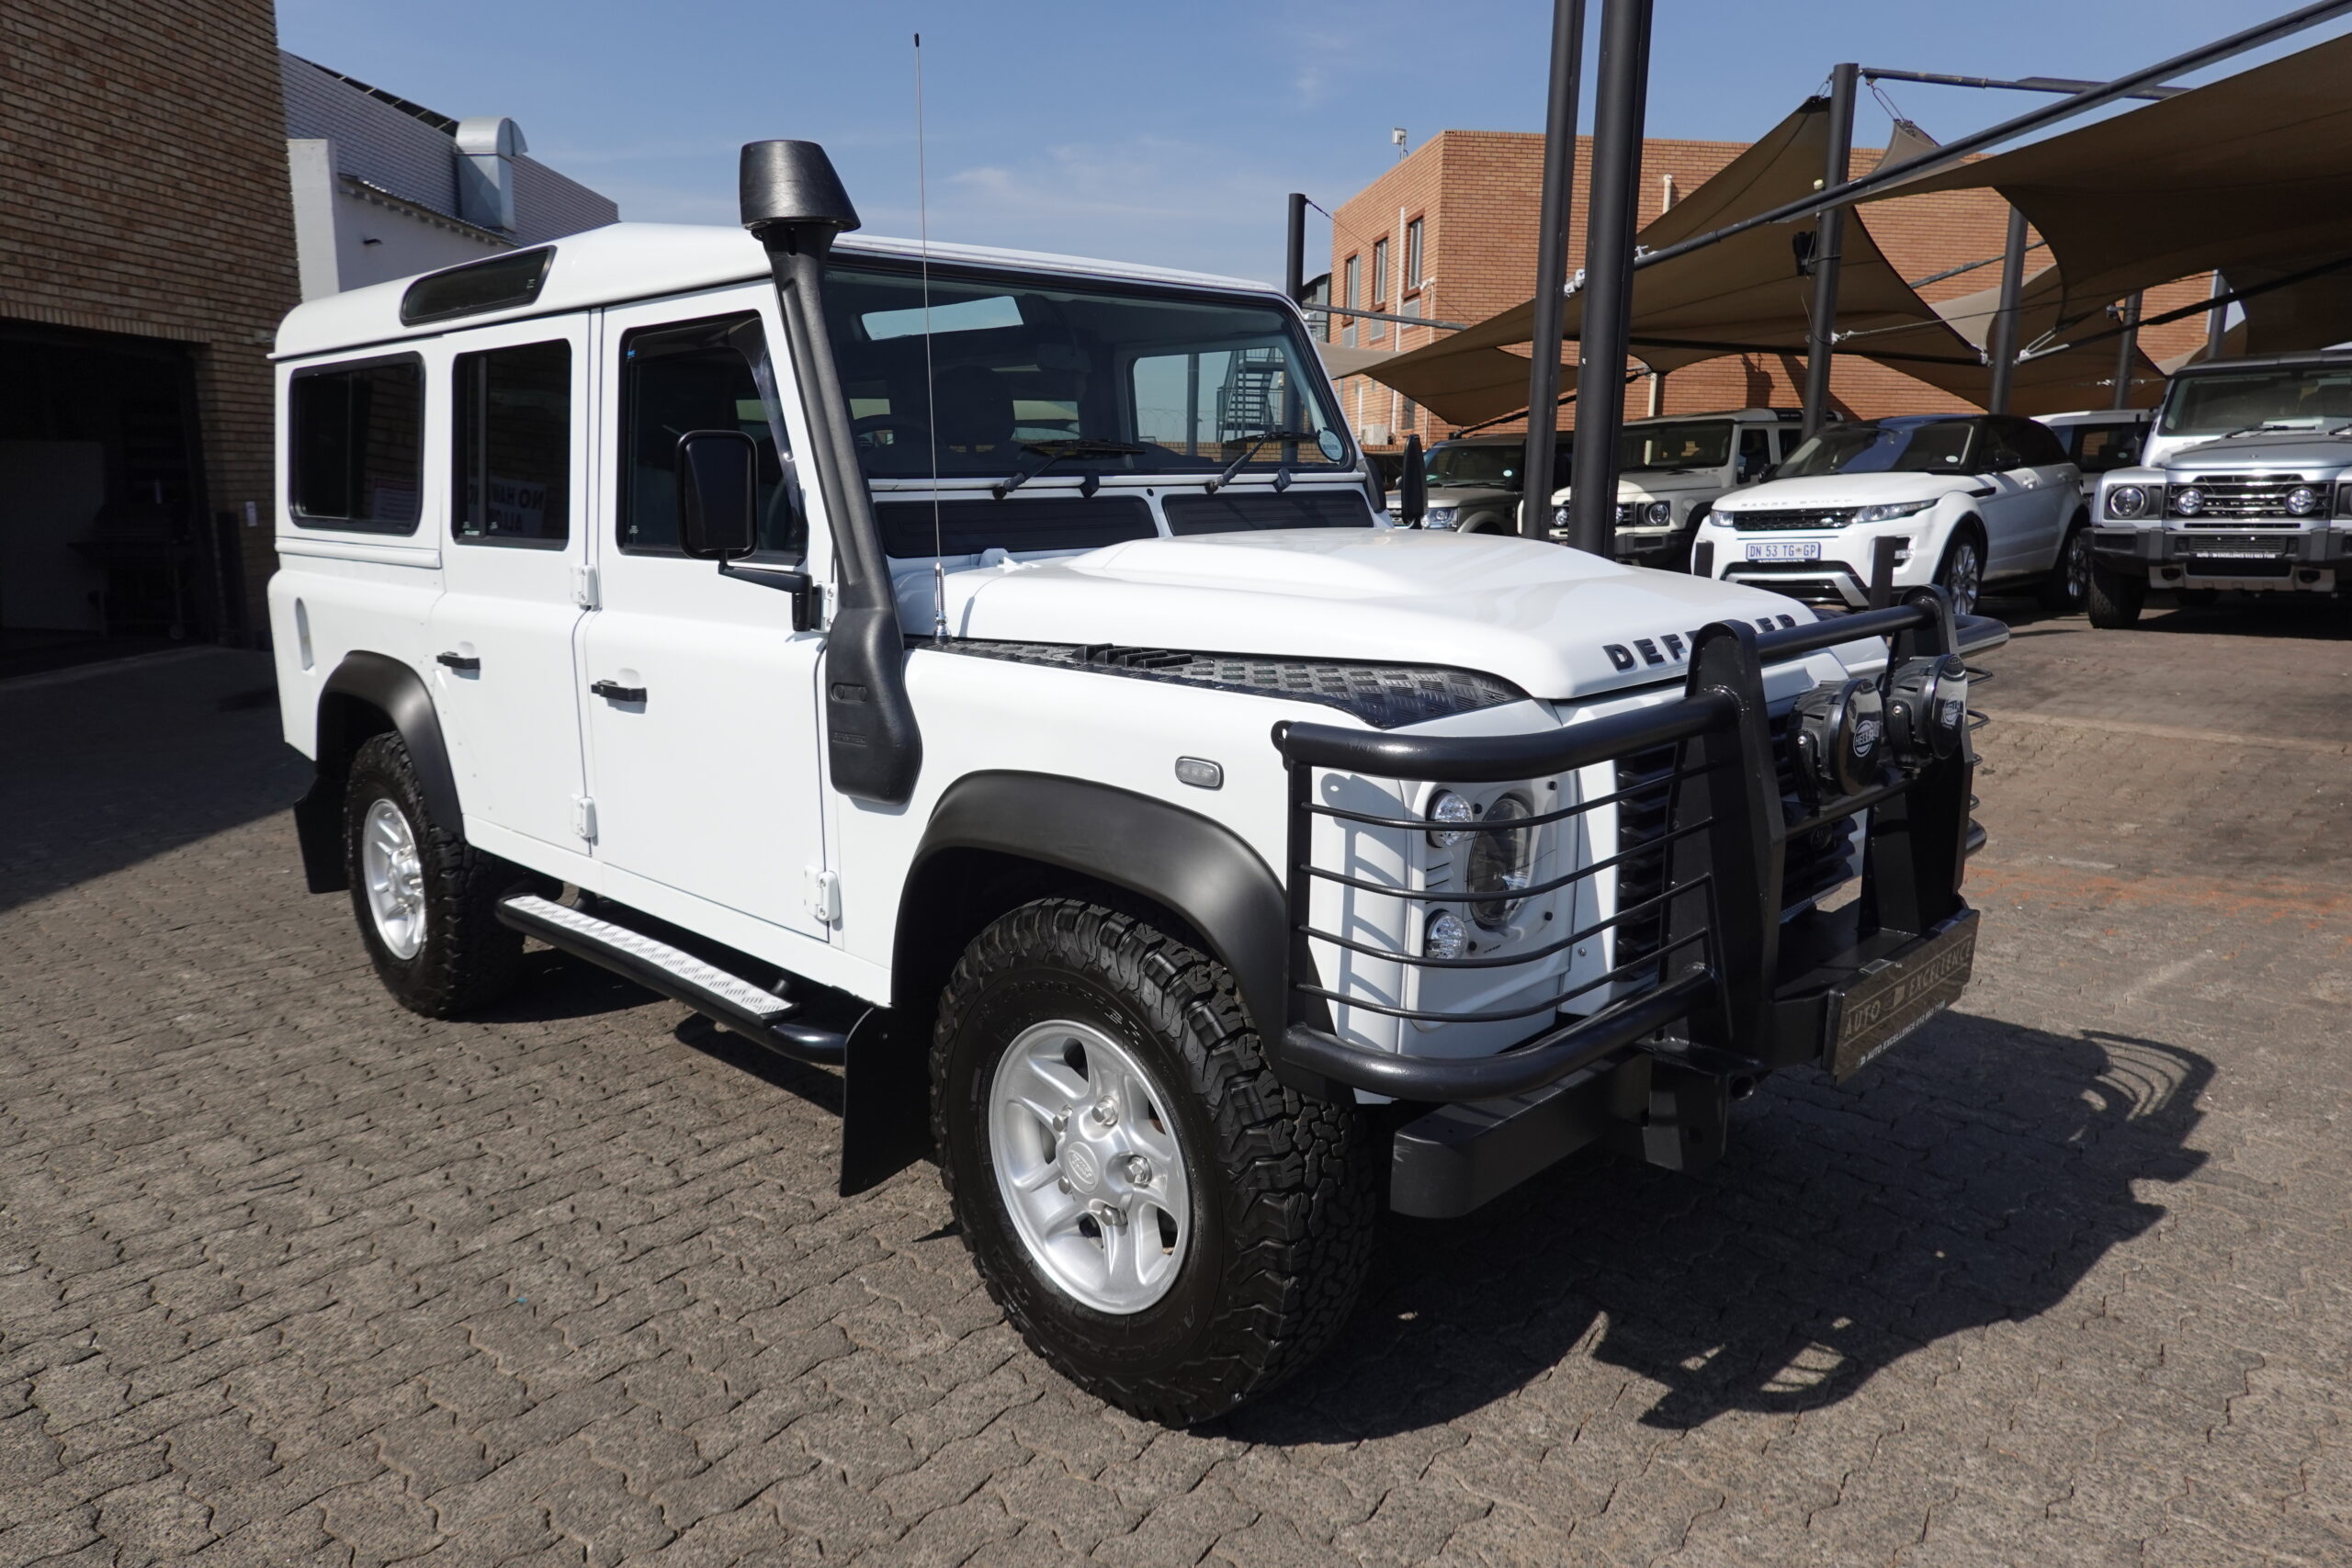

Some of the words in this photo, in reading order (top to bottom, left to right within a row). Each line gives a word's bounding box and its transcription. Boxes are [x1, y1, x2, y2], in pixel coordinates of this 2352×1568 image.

[1749, 546, 1761, 558] DN
[1766, 546, 1778, 557] 53
[1782, 545, 1794, 557] TG
[1804, 545, 1816, 556] GP
[1602, 614, 1797, 672] DEFER
[1844, 999, 1881, 1039] AUTO
[1908, 940, 1973, 998] EXCELLENCE
[1867, 1044, 1883, 1062] AUTO
[1883, 1021, 1916, 1050] EXCELLENCE
